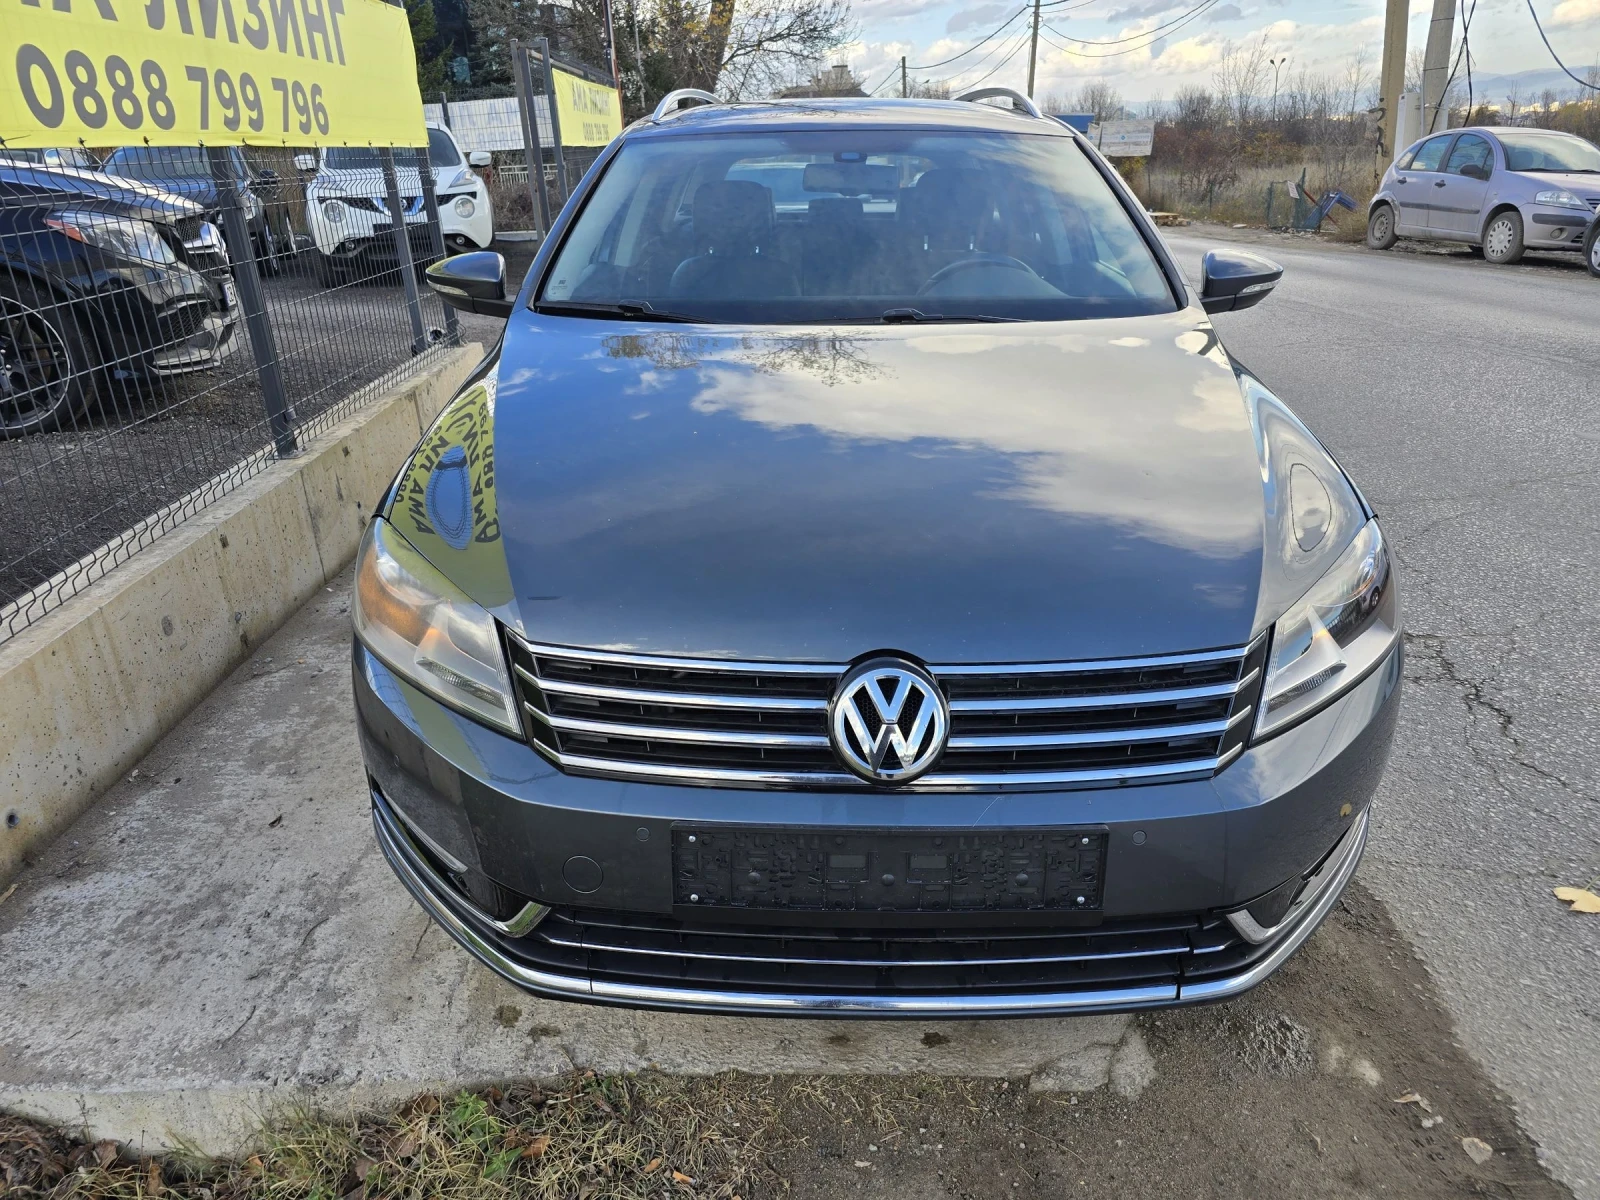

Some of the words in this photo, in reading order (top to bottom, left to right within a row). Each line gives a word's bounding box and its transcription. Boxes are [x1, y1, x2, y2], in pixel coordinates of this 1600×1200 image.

[16, 43, 176, 130] 0888
[185, 64, 264, 132] 799
[271, 77, 330, 136] 796
